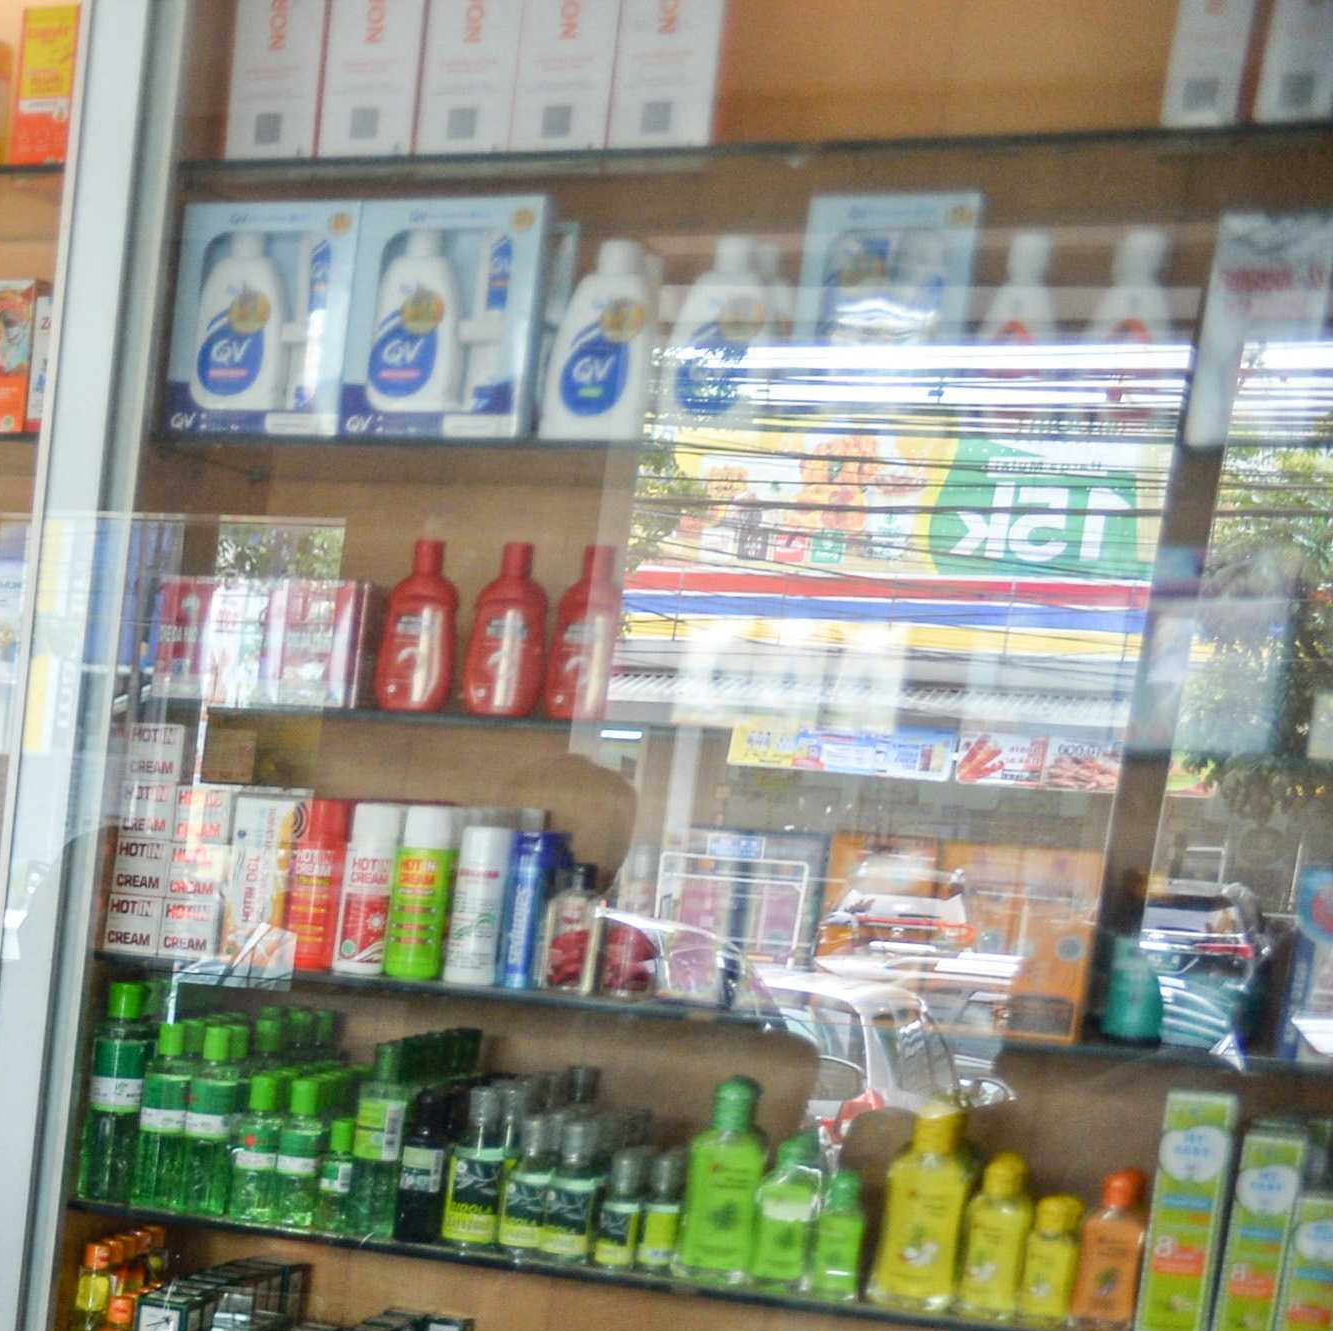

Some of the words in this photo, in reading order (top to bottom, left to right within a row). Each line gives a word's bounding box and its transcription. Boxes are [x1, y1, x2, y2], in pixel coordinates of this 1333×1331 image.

[212, 339, 252, 366] QV
[383, 339, 421, 366] QV
[572, 354, 615, 383] QV
[130, 760, 174, 774] CREAM
[122, 818, 166, 832] CREAM
[294, 863, 332, 876] CREAM
[116, 875, 160, 889] CREAM
[351, 871, 390, 885] CREAM
[400, 873, 435, 885] CREAM
[107, 929, 150, 946] CREAM
[163, 935, 207, 951] CREAM
